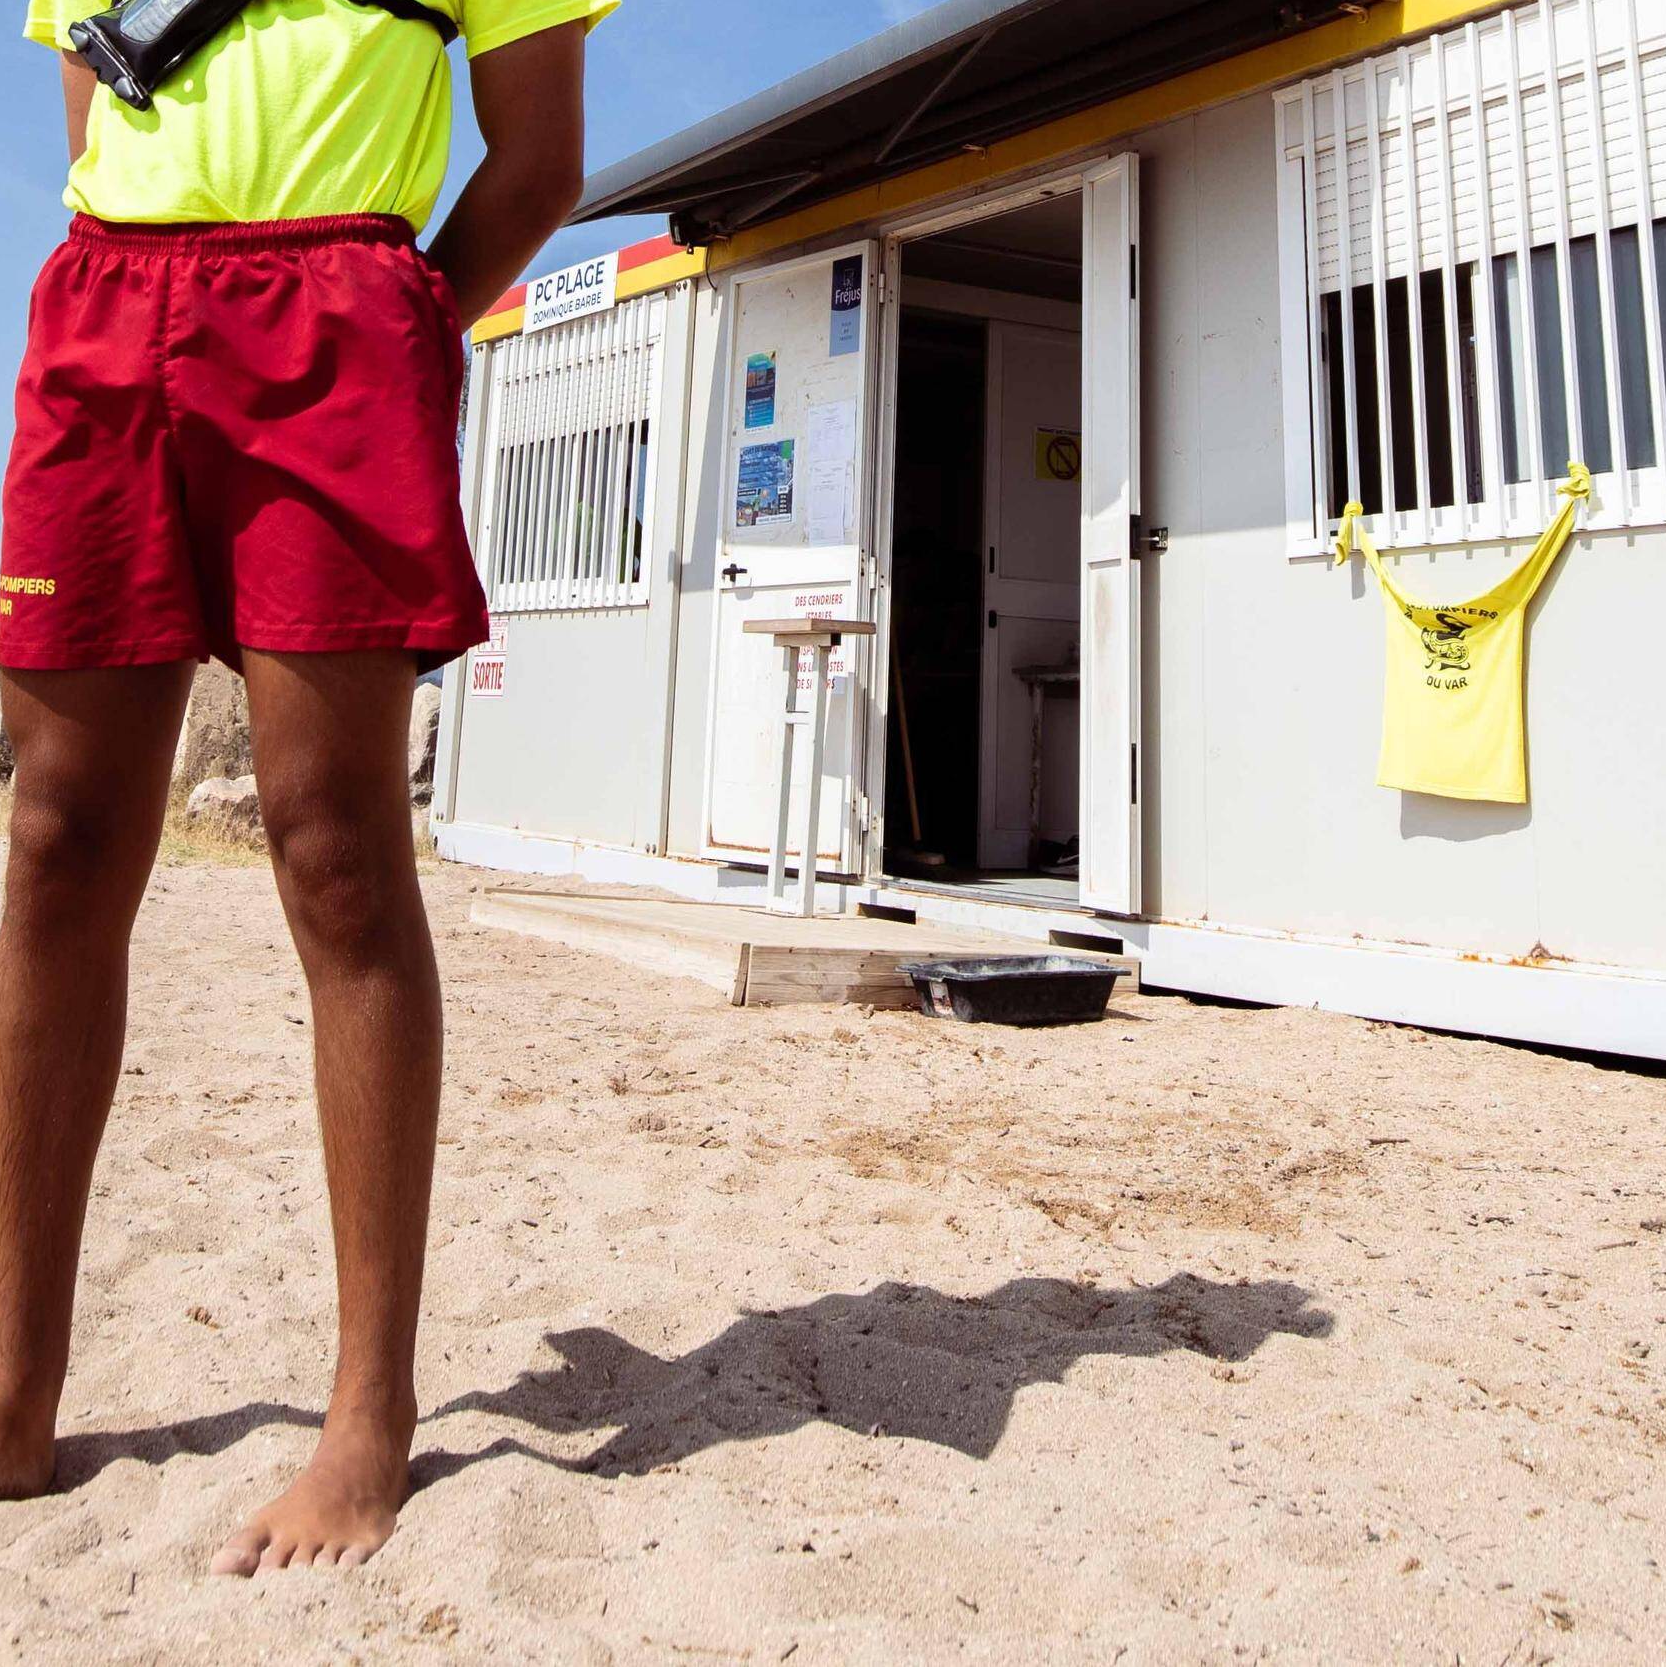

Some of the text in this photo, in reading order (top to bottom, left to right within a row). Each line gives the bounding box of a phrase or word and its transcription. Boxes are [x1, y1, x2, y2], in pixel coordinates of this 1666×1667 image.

[534, 260, 605, 305] PC PLAGE
[533, 288, 602, 324] DOMINIQUE BARBÉ
[835, 286, 861, 306] Fréjus
[808, 593, 843, 607] CENDRIERS
[473, 661, 504, 690] SORTIE
[829, 661, 844, 672] STES
[1426, 675, 1468, 690] DU VAR
